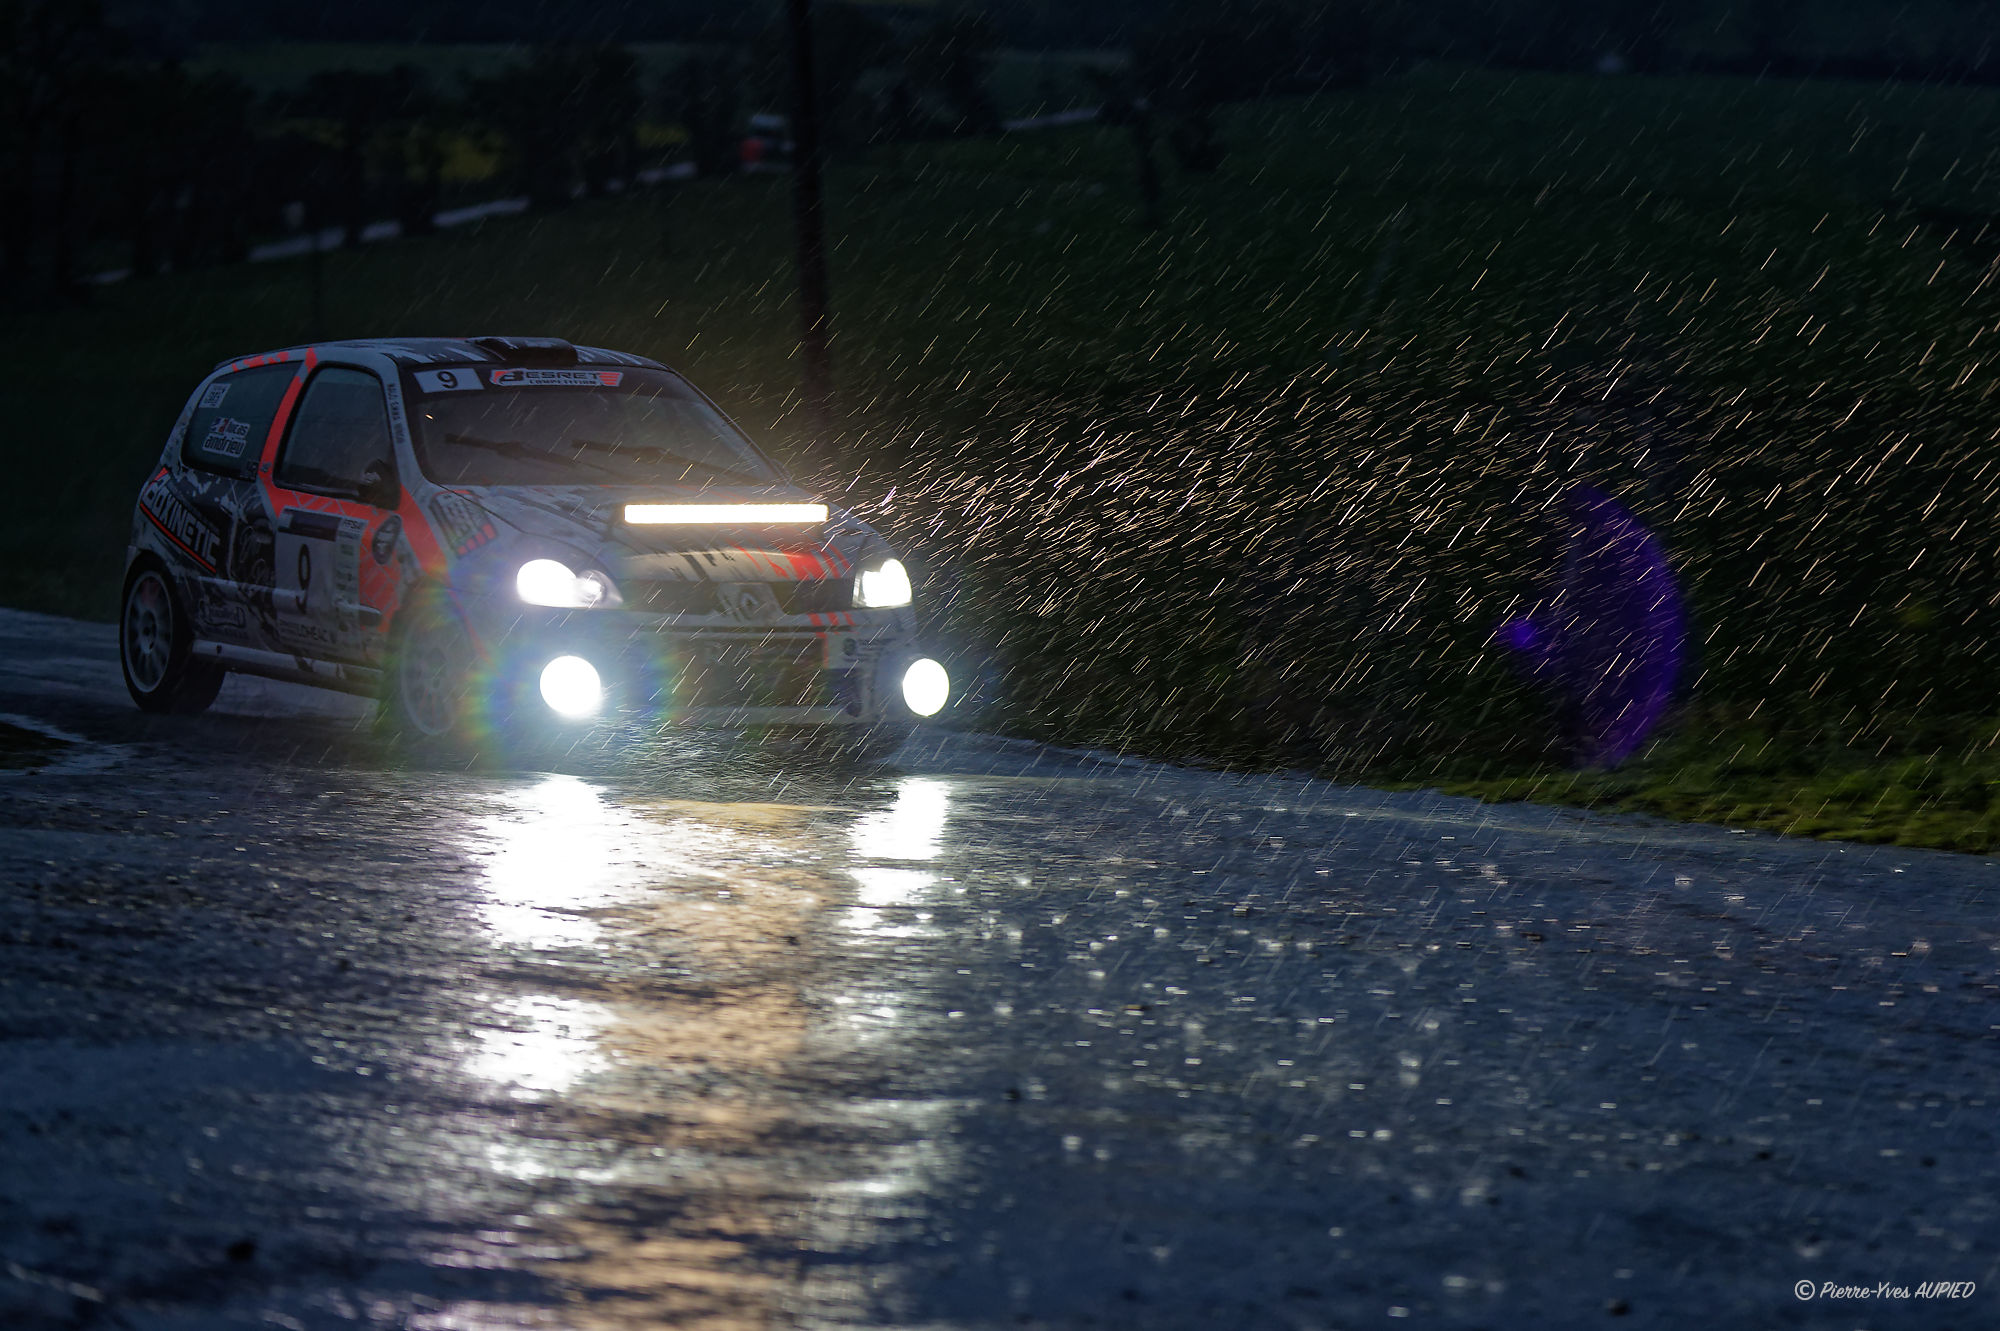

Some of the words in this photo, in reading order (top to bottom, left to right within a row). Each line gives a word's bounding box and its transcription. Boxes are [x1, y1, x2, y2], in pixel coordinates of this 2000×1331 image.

[437, 371, 458, 389] 9
[499, 369, 600, 382] BESRET
[142, 474, 221, 566] BOXINETIC
[296, 544, 311, 615] 9
